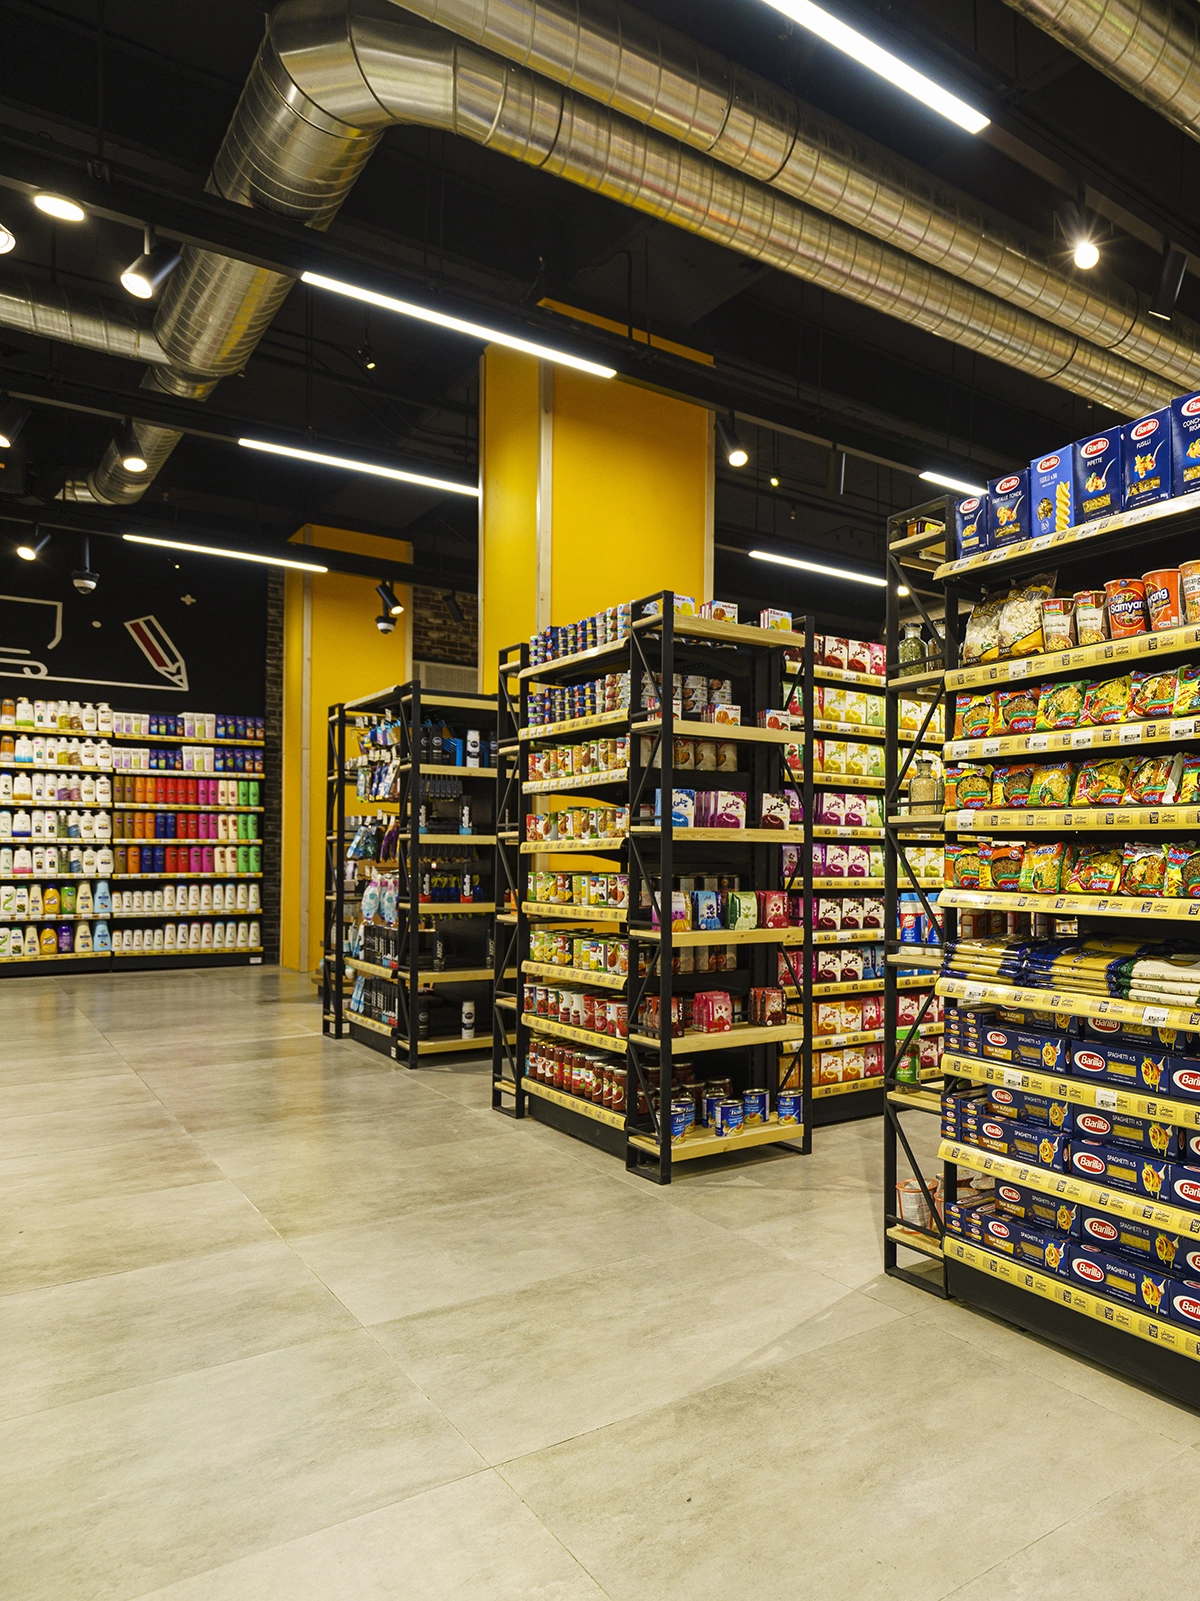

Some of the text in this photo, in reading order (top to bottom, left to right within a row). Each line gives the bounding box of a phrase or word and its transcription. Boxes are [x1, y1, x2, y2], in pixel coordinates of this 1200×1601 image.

[1136, 439, 1151, 449] FUSILLI
[1107, 1050, 1128, 1060] SPAGHETTI
[1112, 1114, 1133, 1124] SPAGHETTI
[1107, 1154, 1128, 1165] SPAGHETTI
[1120, 1222, 1140, 1232] SPAGHETTI
[1106, 1263, 1128, 1275] SPAGHETTI
